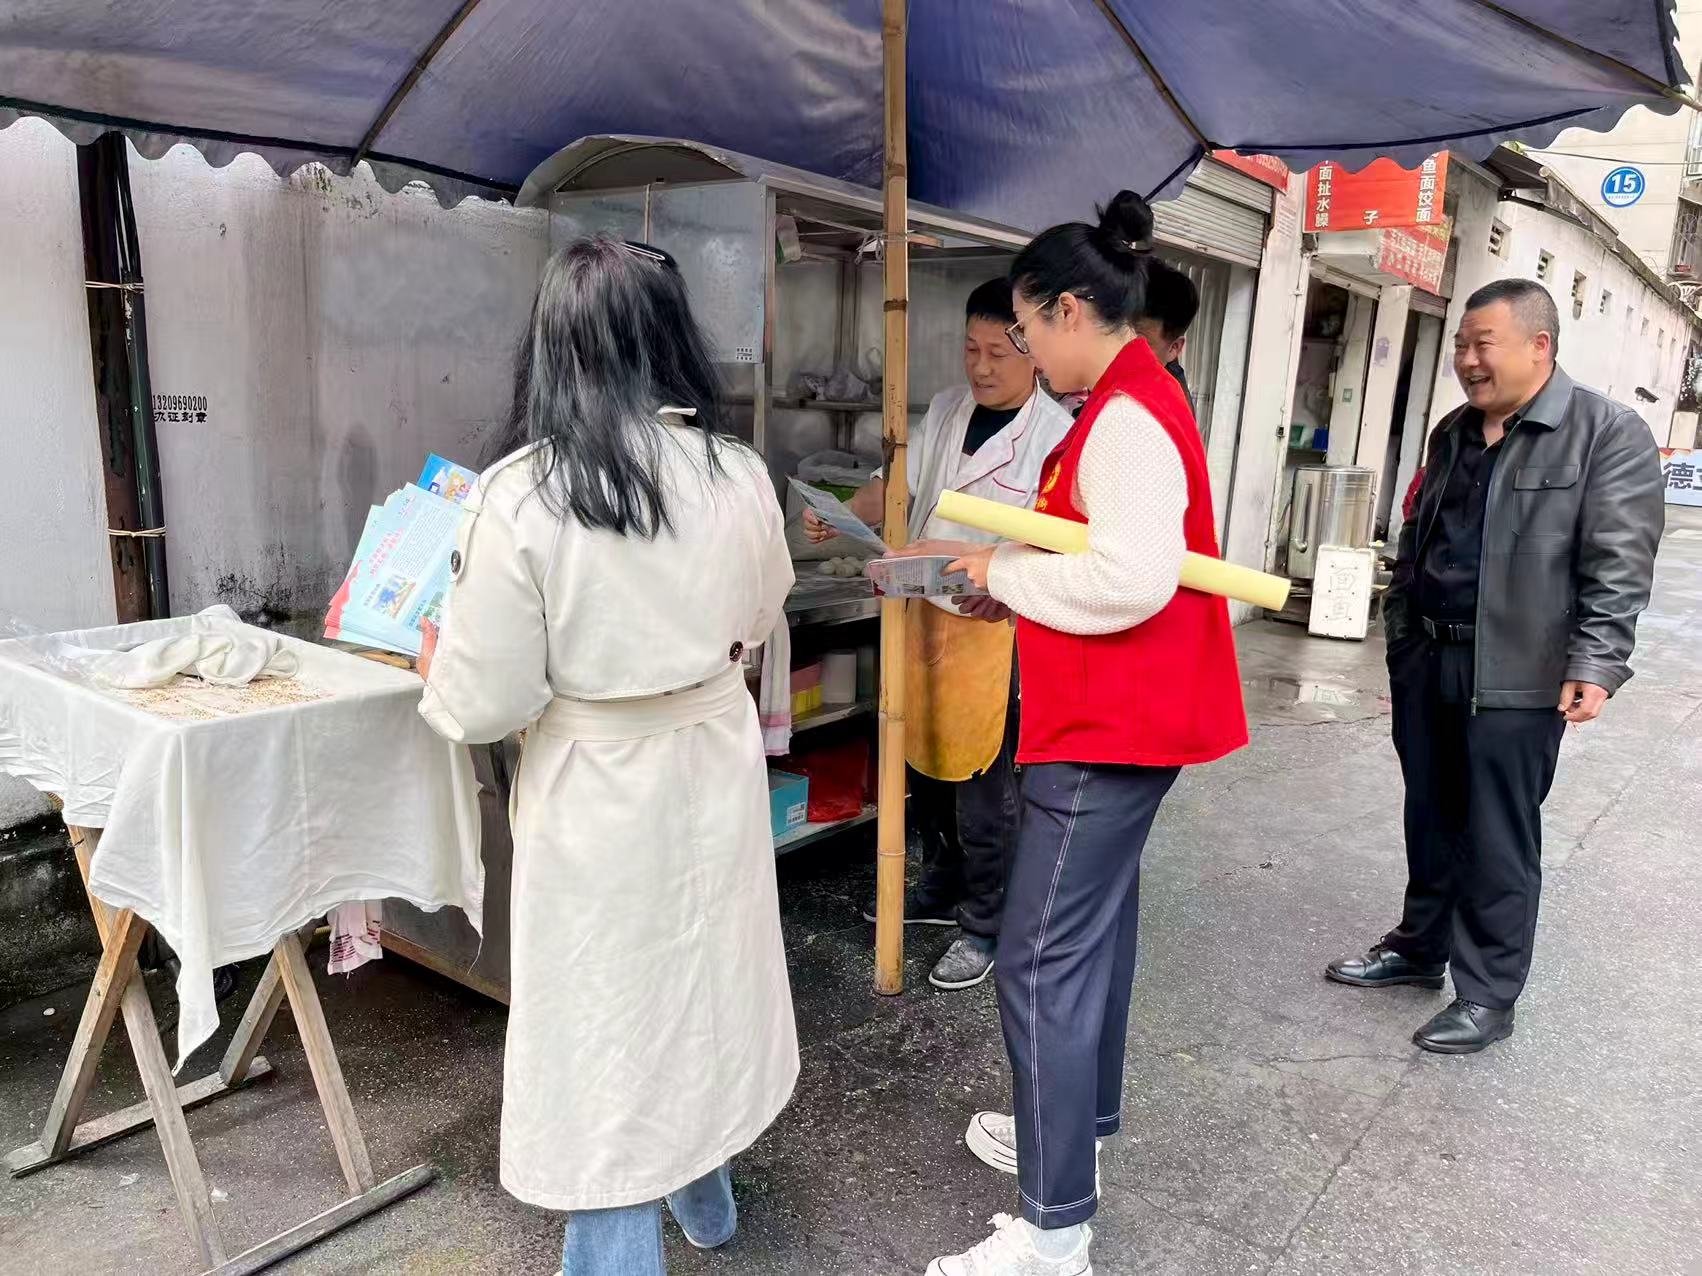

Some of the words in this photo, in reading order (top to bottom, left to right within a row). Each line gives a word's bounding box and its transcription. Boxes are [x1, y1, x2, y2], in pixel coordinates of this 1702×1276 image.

[1611, 174, 1637, 193] 15
[1363, 210, 1379, 225] 子
[152, 394, 208, 411] 13209690200
